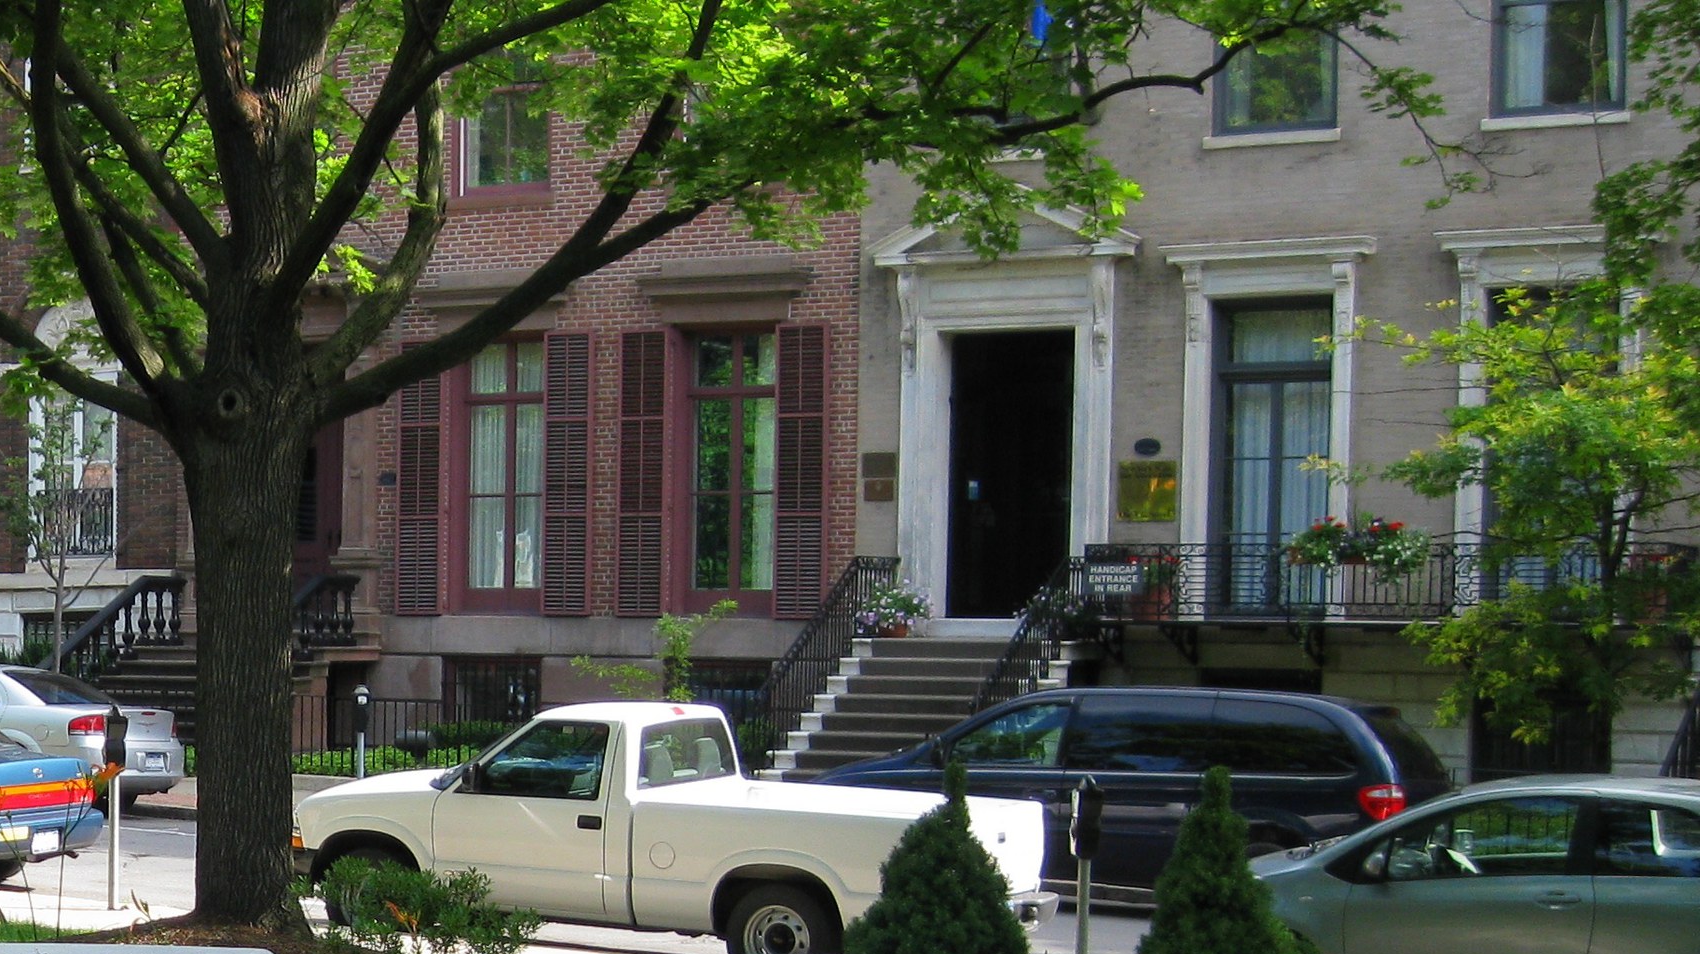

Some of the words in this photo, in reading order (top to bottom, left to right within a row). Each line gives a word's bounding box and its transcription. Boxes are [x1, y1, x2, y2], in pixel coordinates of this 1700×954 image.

[1089, 565, 1137, 574] HANDICAP
[1088, 574, 1138, 583] ENTRANCE
[1094, 583, 1104, 592] IN
[1106, 583, 1132, 592] REAR
